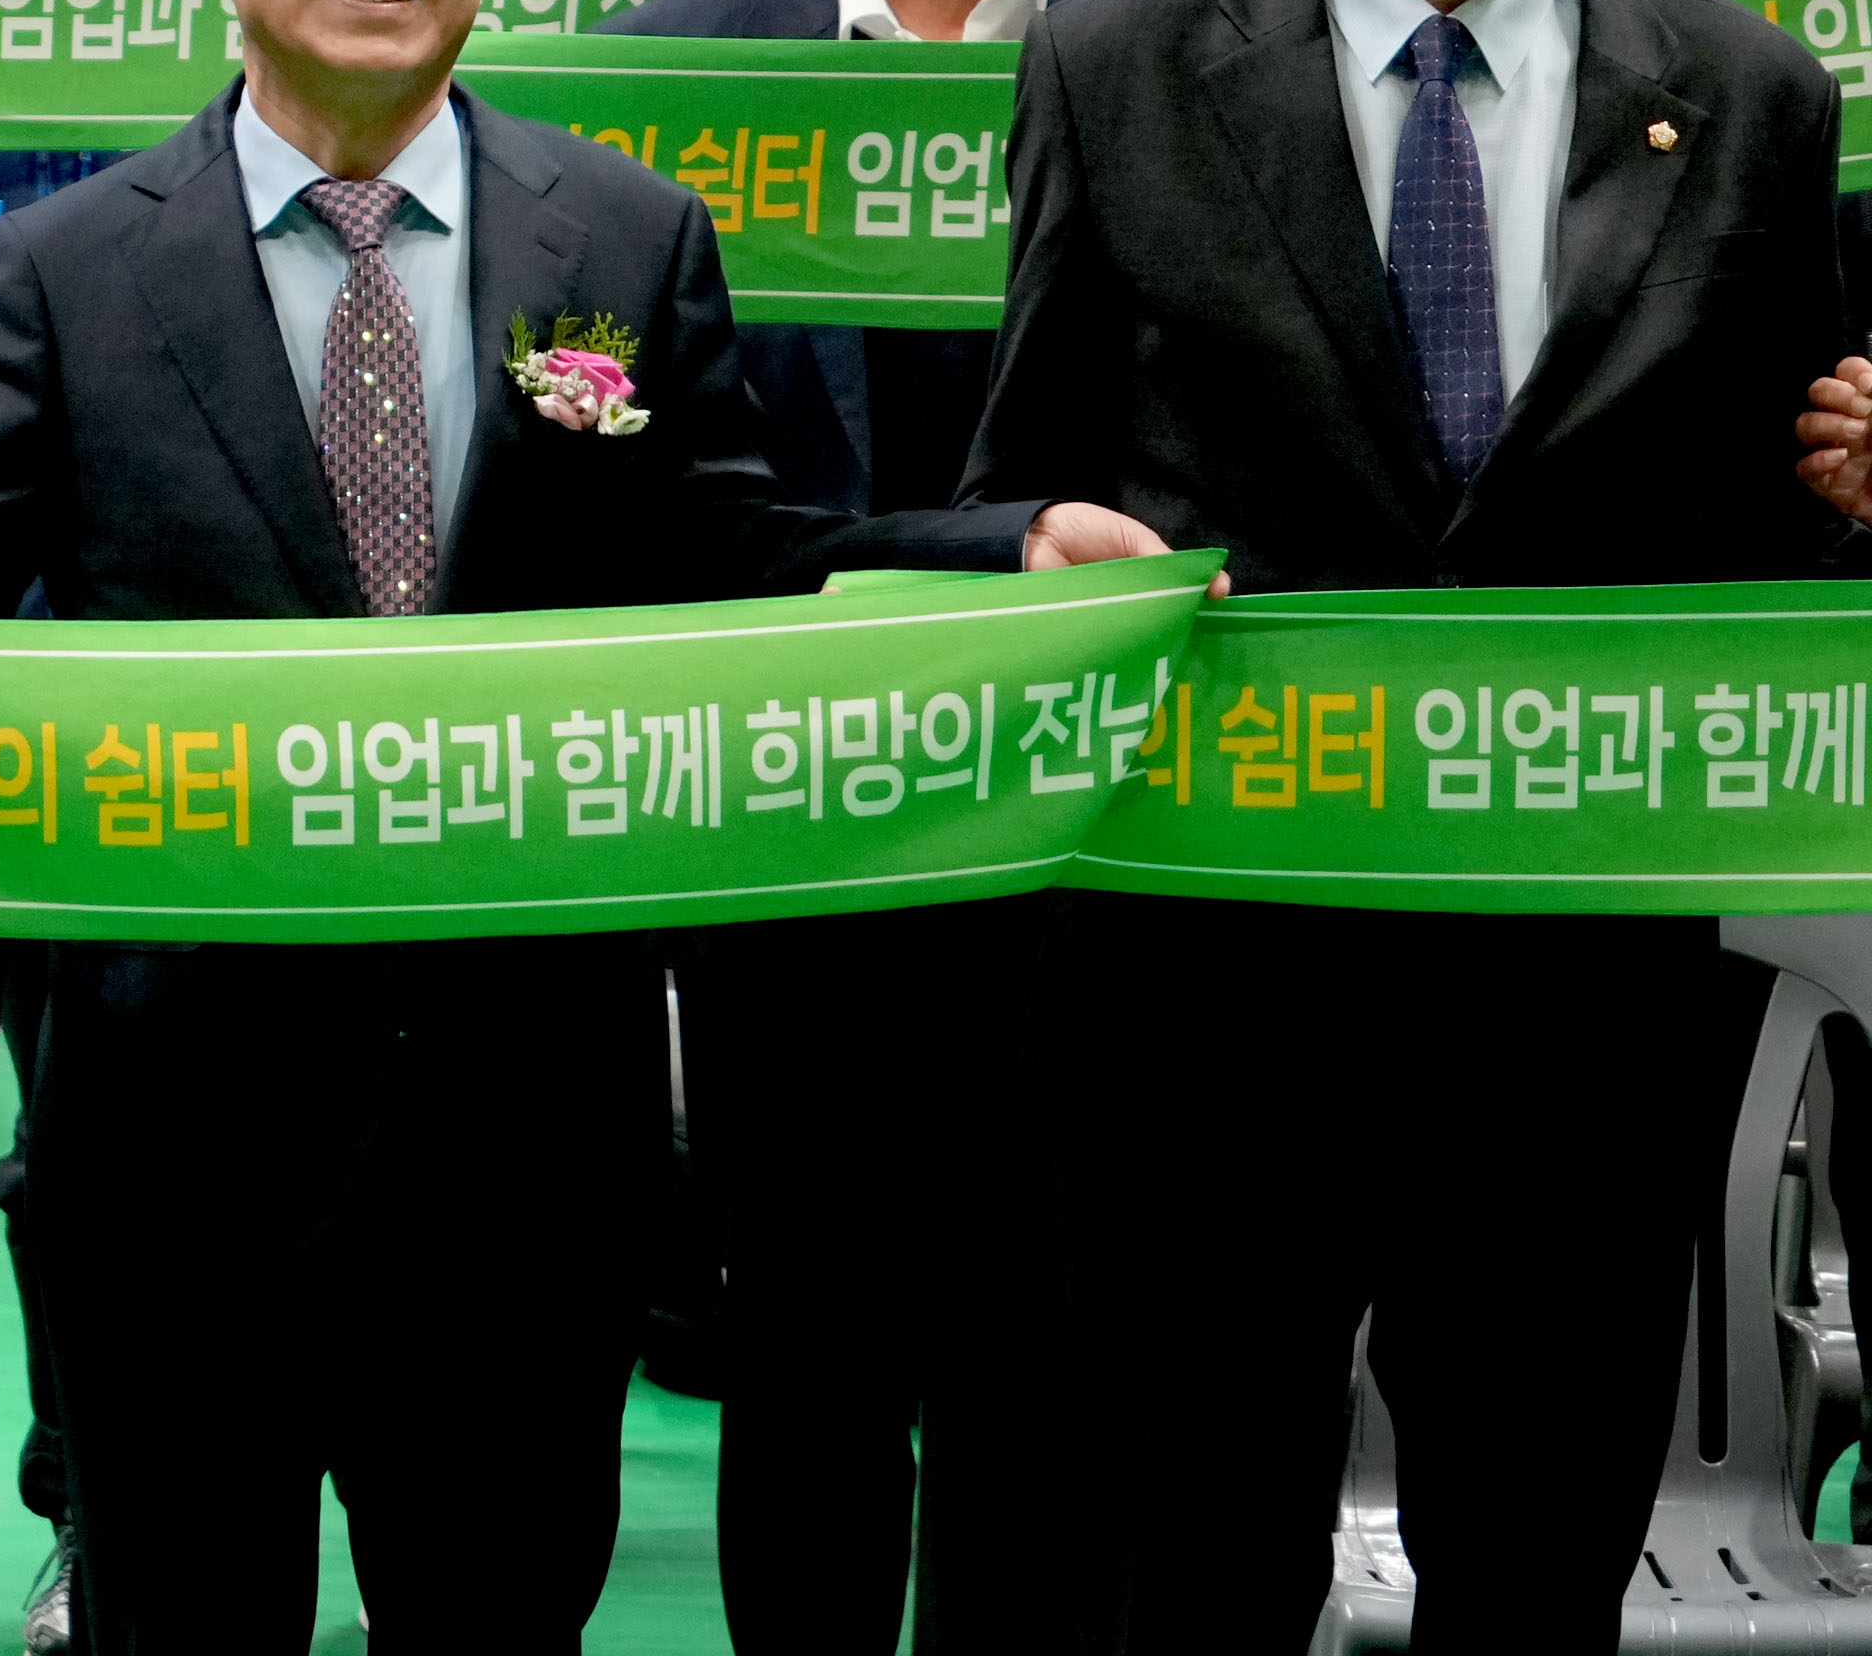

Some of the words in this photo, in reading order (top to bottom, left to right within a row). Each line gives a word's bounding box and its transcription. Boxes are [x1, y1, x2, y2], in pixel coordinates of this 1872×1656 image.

[675, 126, 827, 237] 쉼터
[846, 128, 1010, 240] 임업
[82, 722, 255, 847] 쉼터
[276, 714, 535, 844] 임업과
[550, 714, 726, 834] 함께
[746, 682, 998, 822] 희망의
[1018, 656, 1171, 799] 전남
[1217, 684, 1386, 810] 쉼터
[1413, 684, 1676, 810] 임업과
[1694, 682, 1867, 808] 함께
